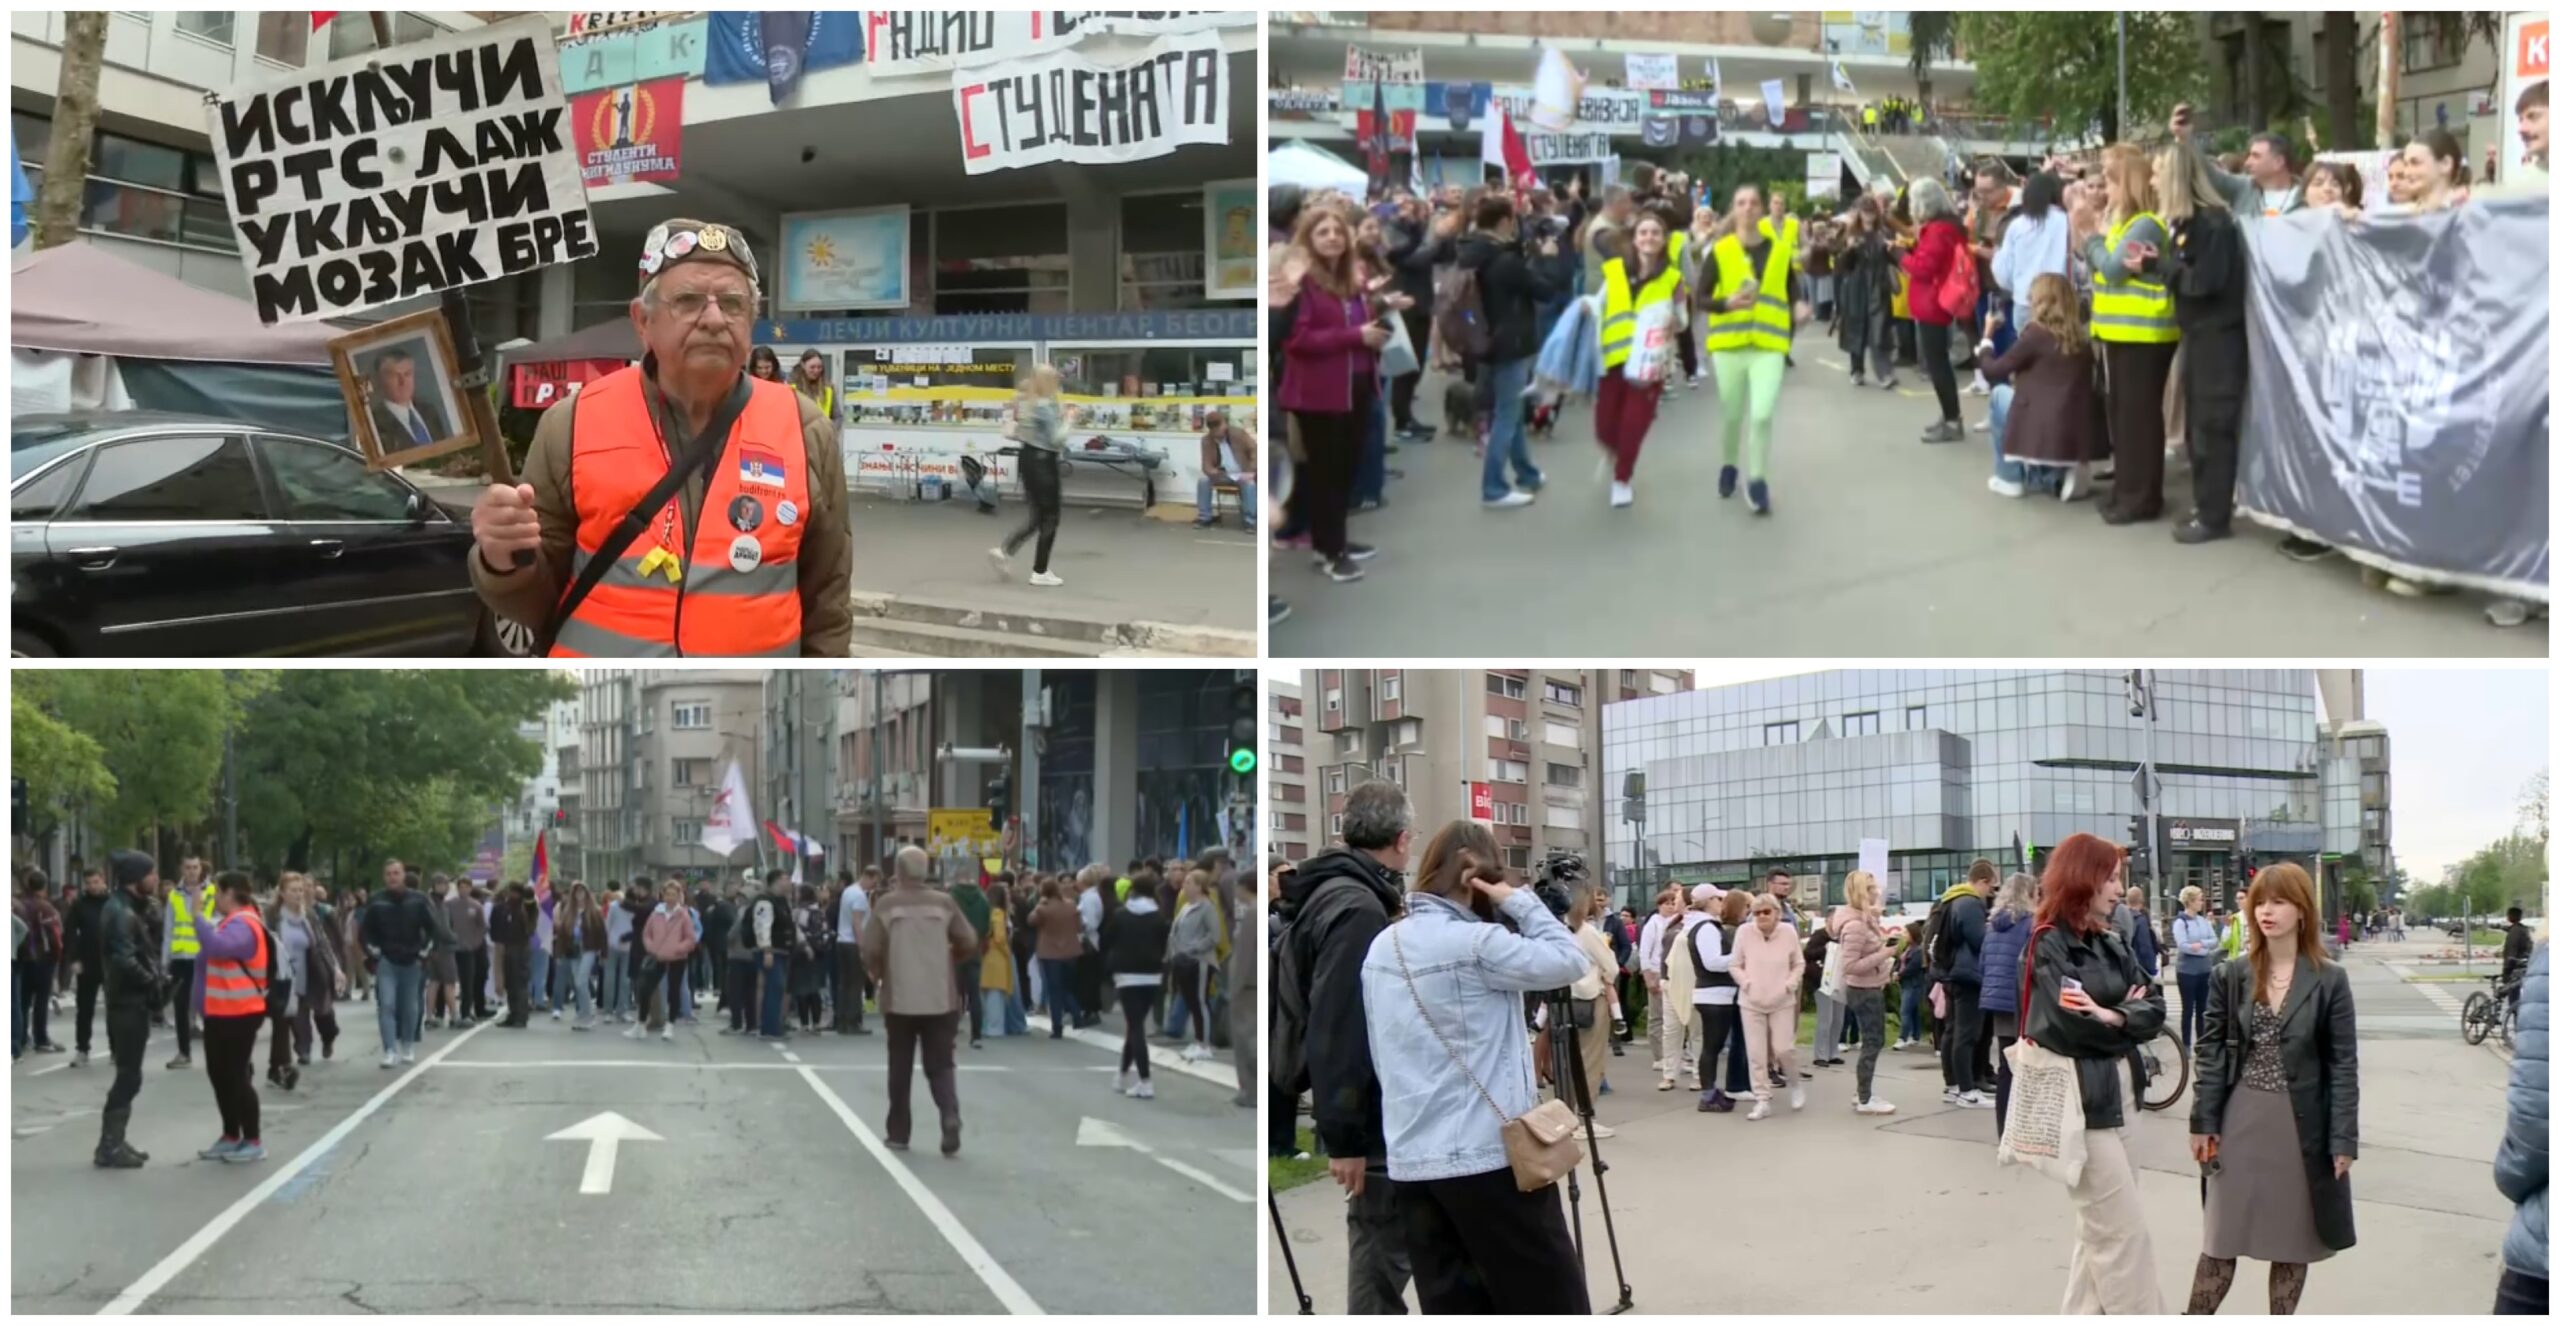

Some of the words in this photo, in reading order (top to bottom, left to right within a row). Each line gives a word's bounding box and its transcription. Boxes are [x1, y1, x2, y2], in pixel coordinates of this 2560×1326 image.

[220, 37, 545, 159] ИСКЉУЧИ
[960, 48, 1217, 160] СТУДЕНАТА
[231, 137, 384, 215] РТС
[415, 107, 564, 178] ЛАЖ
[587, 143, 657, 164] СТУДЕНТИ
[238, 161, 550, 268] УКЉУЧИ
[254, 228, 488, 324] МОЗАК
[496, 209, 596, 275] БРЕ
[818, 320, 889, 341] ДЕЧЈИ
[901, 315, 1032, 338] КУЛТУРНИ
[1044, 315, 1152, 338] ЦЕНТАР
